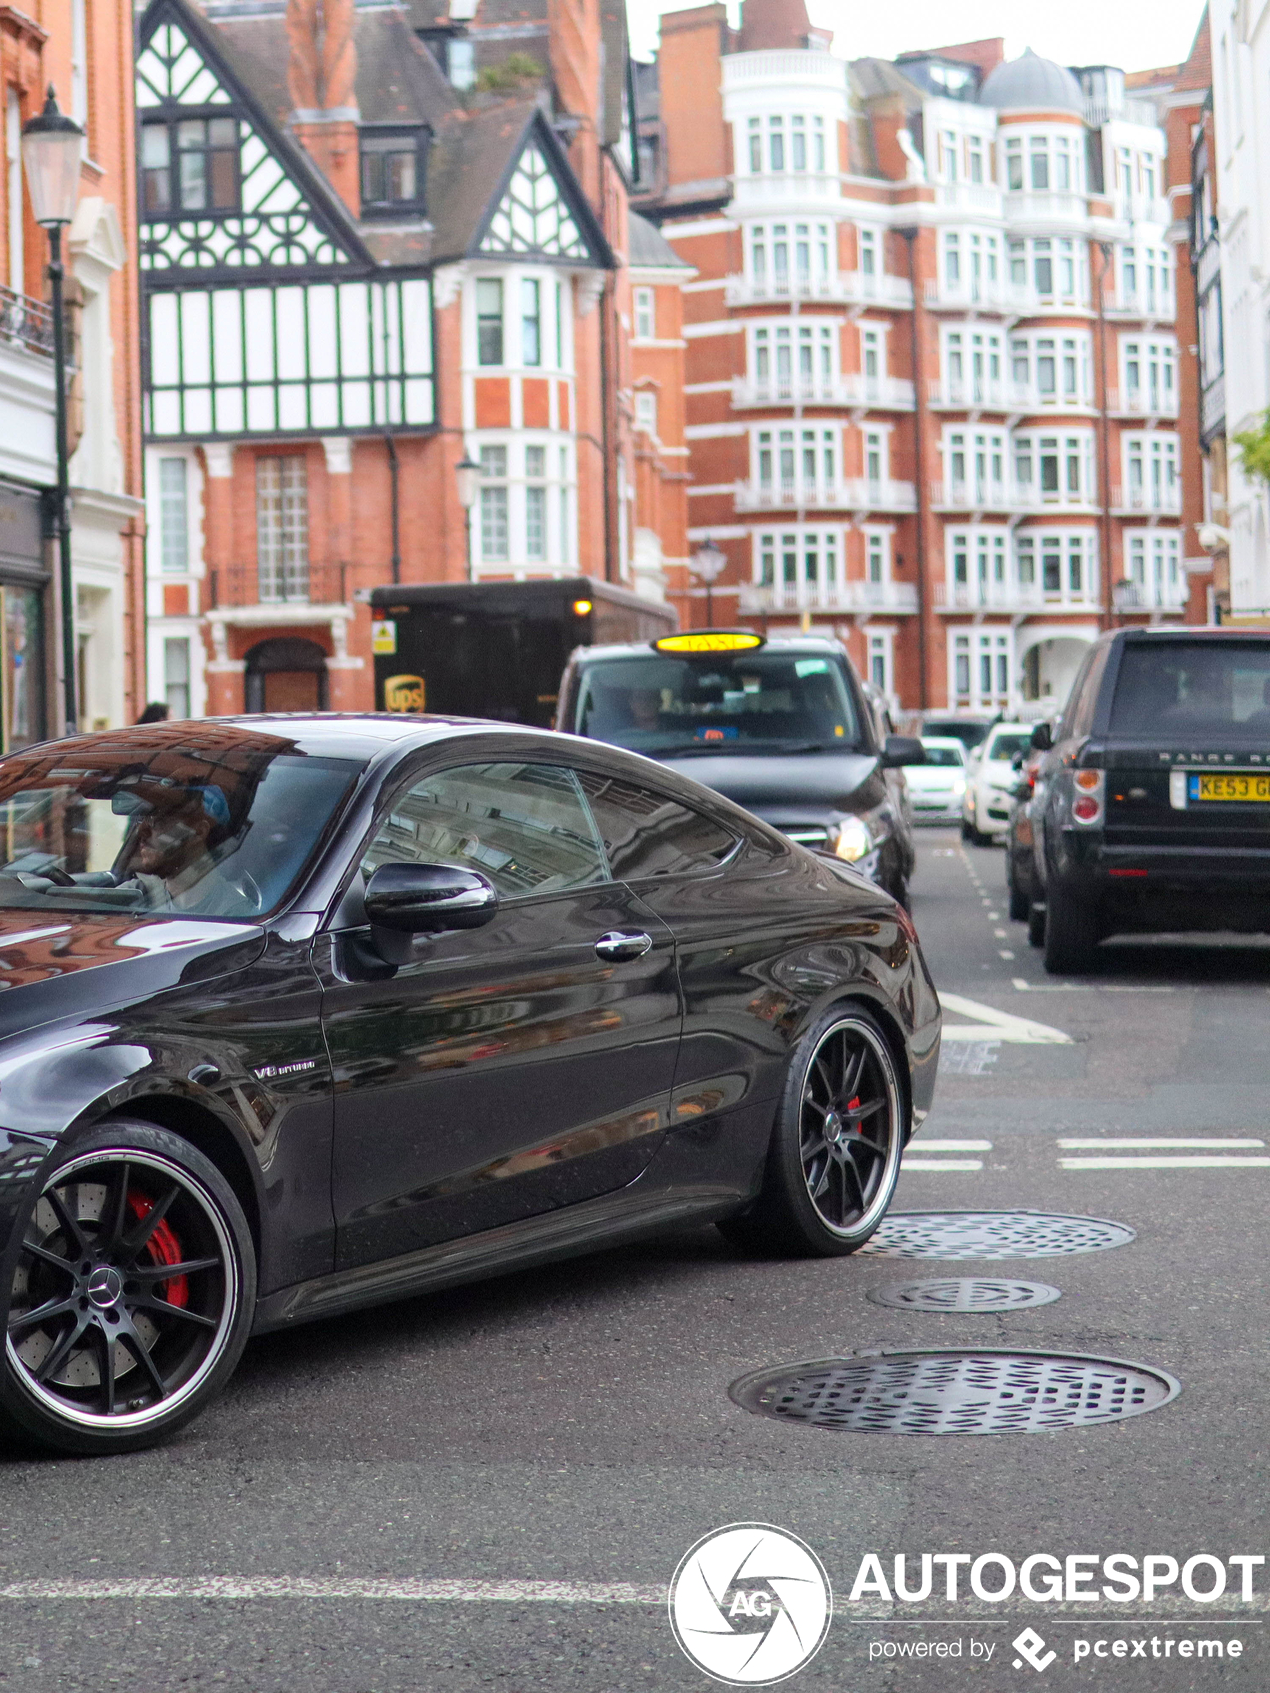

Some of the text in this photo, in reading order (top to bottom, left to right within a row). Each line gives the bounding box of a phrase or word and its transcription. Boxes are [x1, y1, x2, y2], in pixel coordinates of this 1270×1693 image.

[1200, 779, 1270, 796] KE53 G
[253, 1066, 277, 1079] V8
